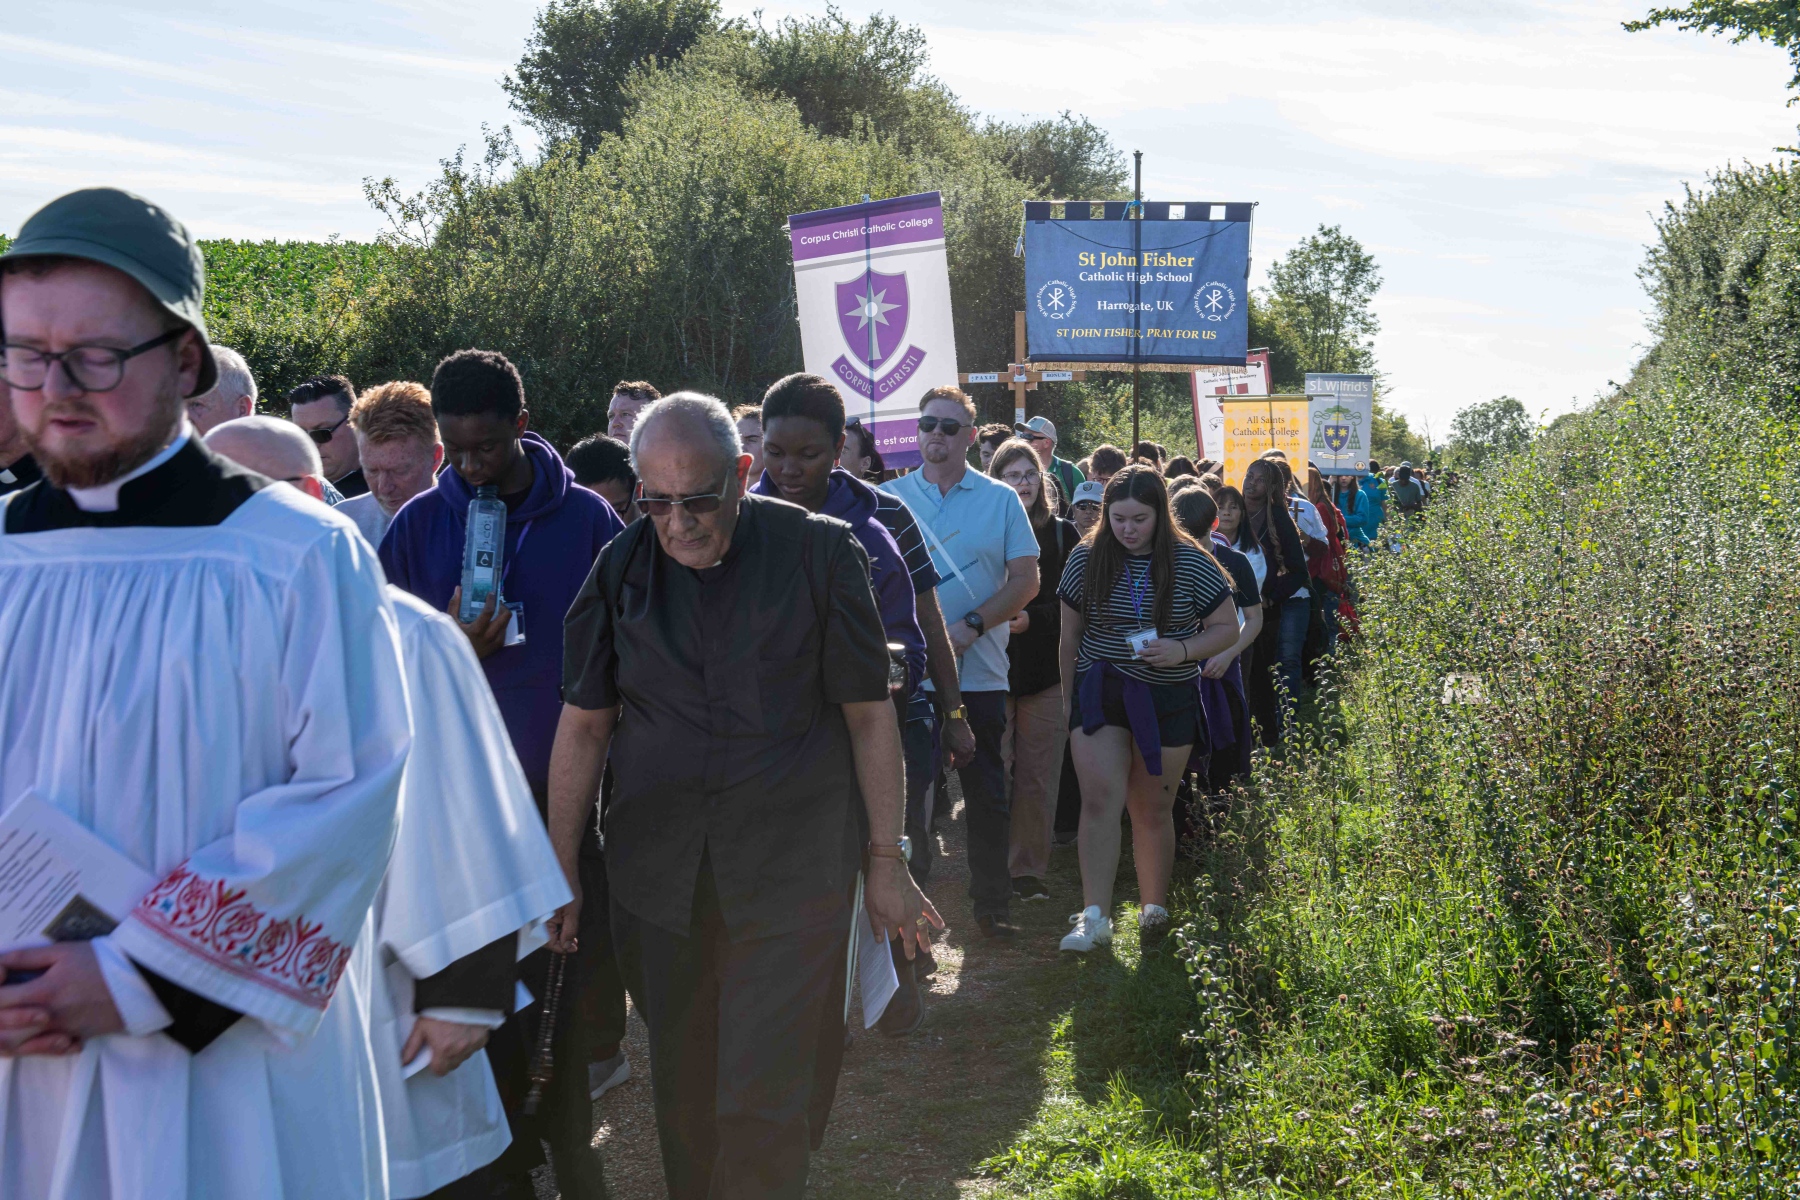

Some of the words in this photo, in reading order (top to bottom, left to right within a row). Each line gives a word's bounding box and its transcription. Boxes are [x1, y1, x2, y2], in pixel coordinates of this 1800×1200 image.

[800, 234, 831, 245] Corpus
[832, 228, 859, 240] Christi
[860, 222, 896, 234] Catholic
[898, 217, 934, 229] College
[1078, 251, 1096, 267] St
[1099, 252, 1138, 270] John
[1142, 252, 1195, 267] Fisher
[1079, 271, 1125, 282] Catholic
[1126, 272, 1153, 285] High
[1156, 272, 1193, 282] School
[1097, 300, 1154, 313] Harrogate,
[1156, 300, 1174, 311] UK
[1056, 328, 1069, 338] ST
[1071, 328, 1102, 339] JOHN
[1104, 328, 1144, 339] FISHER,
[1146, 328, 1174, 338] PRAY
[1175, 329, 1199, 339] FOR
[1201, 330, 1217, 340] US
[839, 364, 873, 394] CORPUS
[879, 355, 918, 393] CHRISTI
[1325, 380, 1369, 392] Wilfrid's
[1246, 416, 1259, 424] All
[1260, 416, 1285, 424] Saints
[1232, 427, 1266, 436] Catholic
[1269, 427, 1300, 438] College
[883, 436, 897, 445] est
[899, 435, 918, 444] orar
